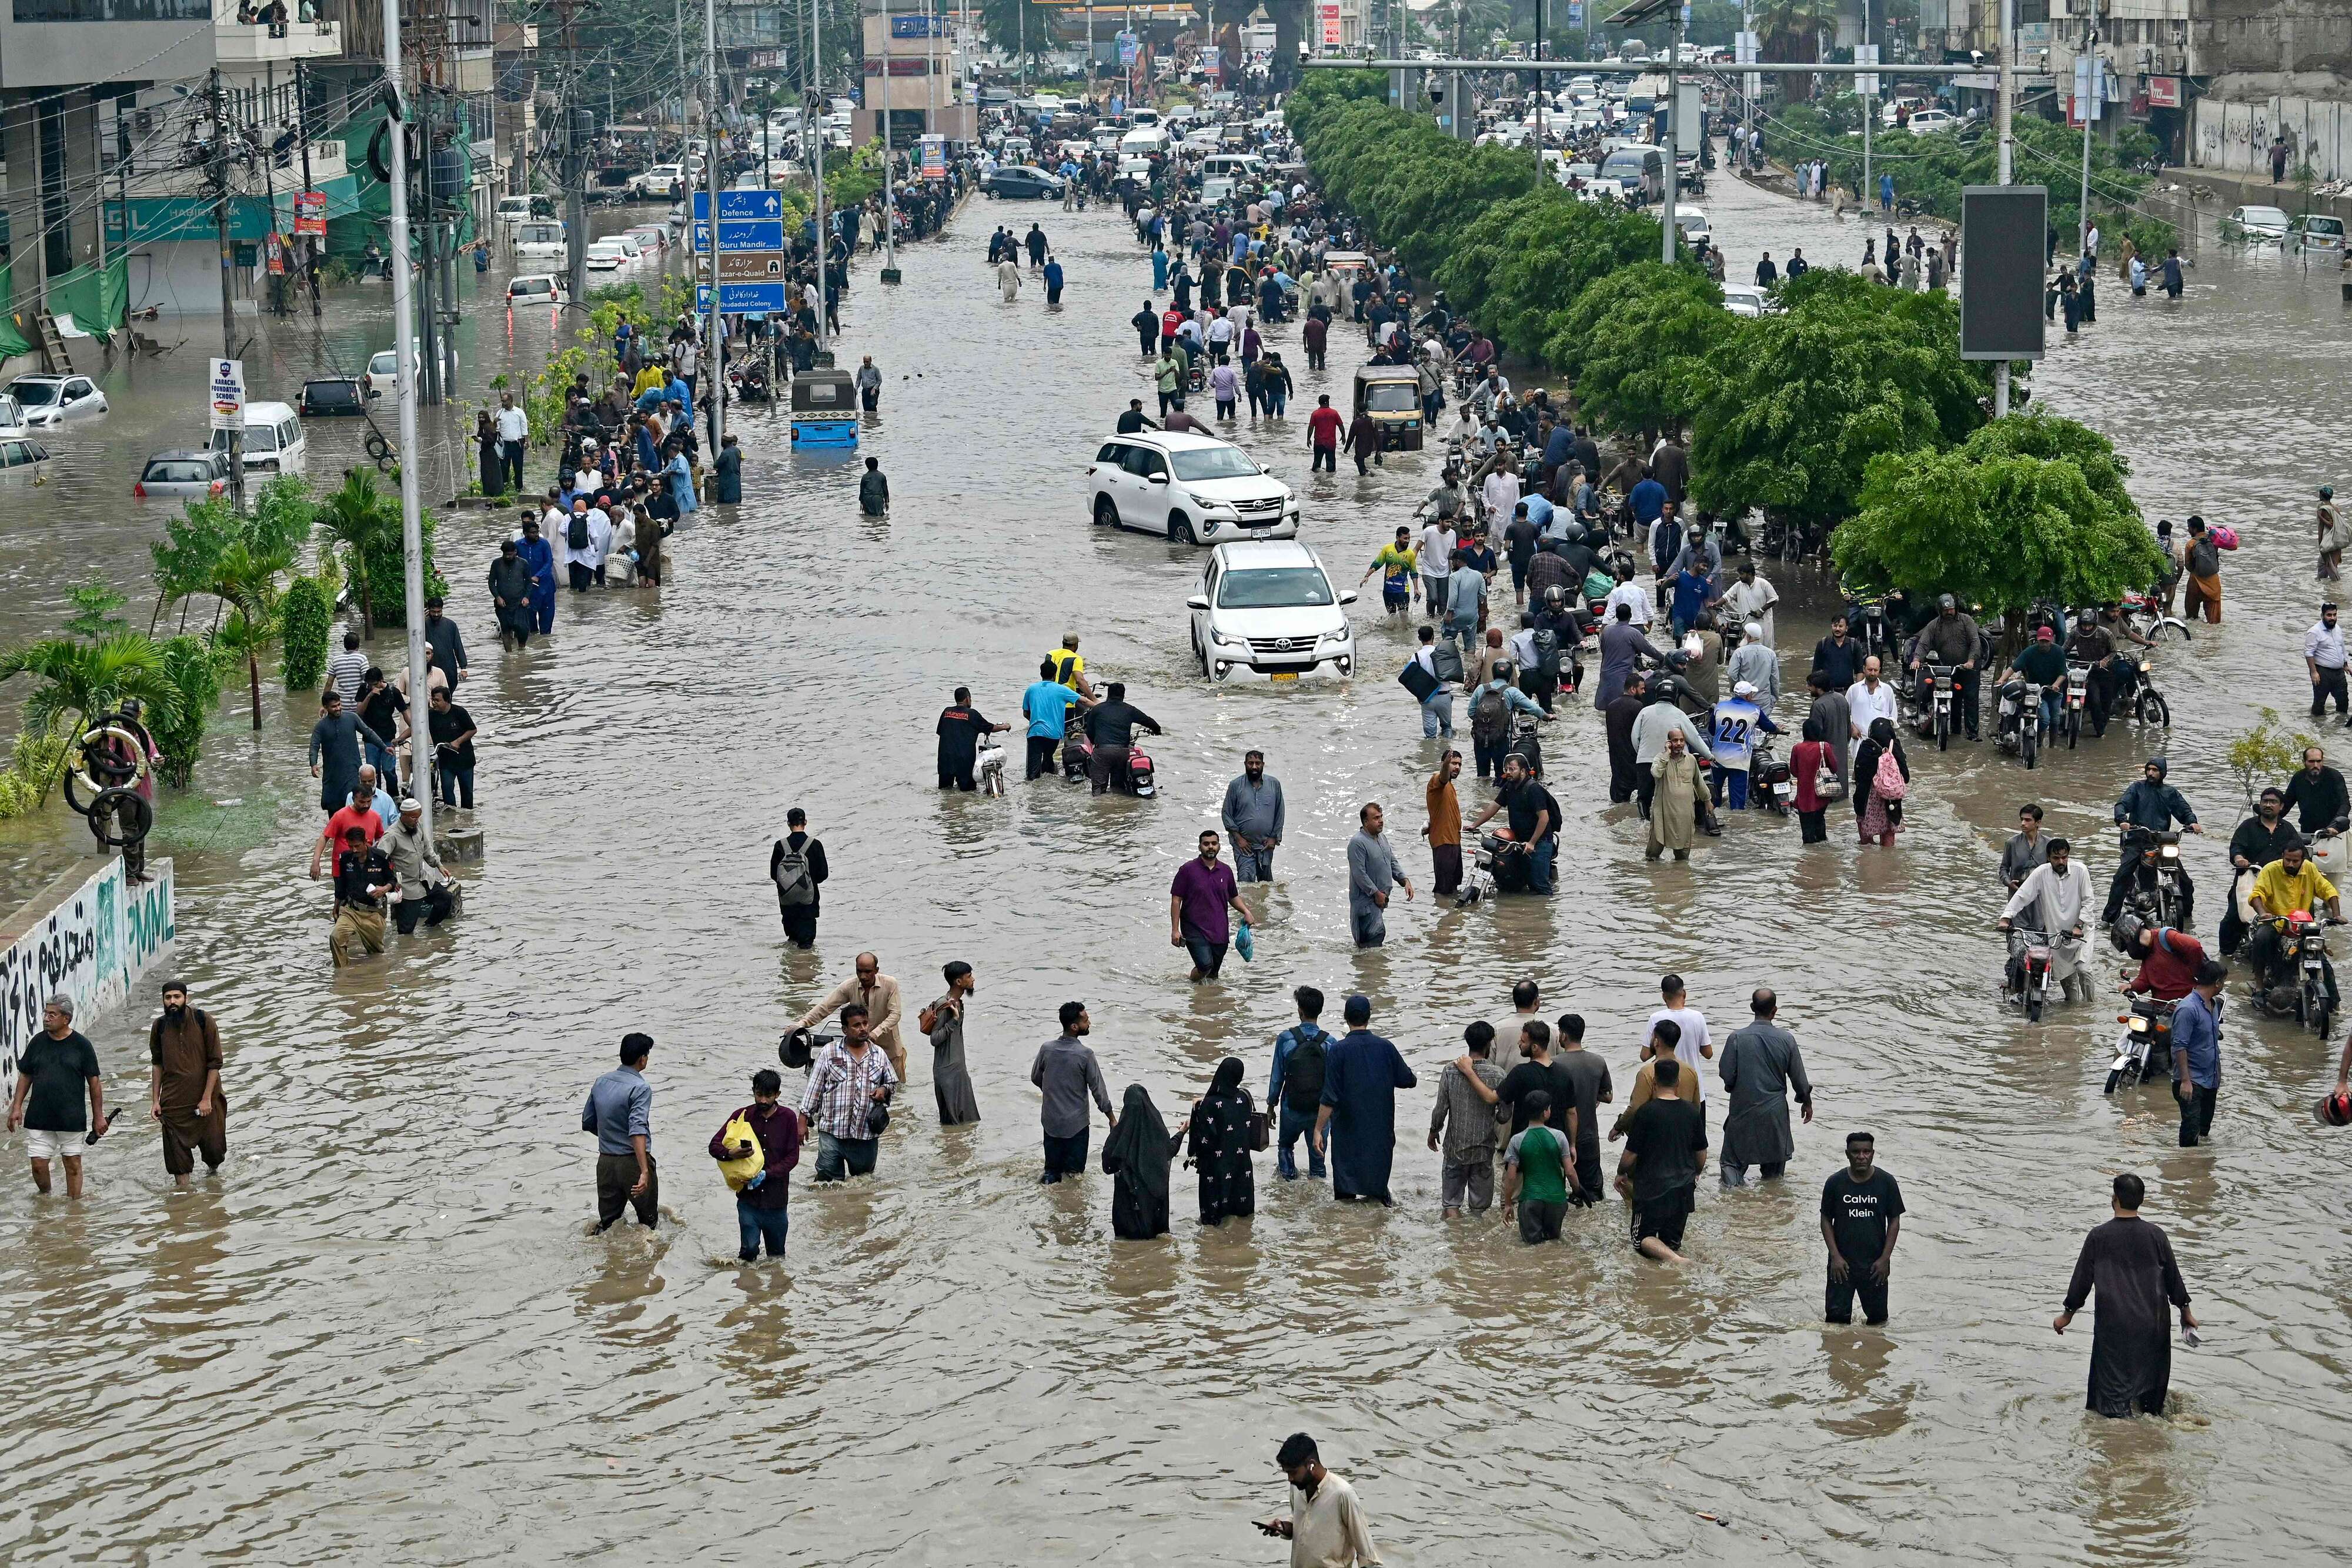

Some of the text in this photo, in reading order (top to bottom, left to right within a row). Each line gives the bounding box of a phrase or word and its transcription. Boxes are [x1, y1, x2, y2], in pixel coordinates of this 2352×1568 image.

[211, 385, 240, 393] FOUNDATION
[1719, 717, 1748, 744] 22
[1843, 1194, 1877, 1204] Calvin
[1849, 1209, 1874, 1218] Klein
